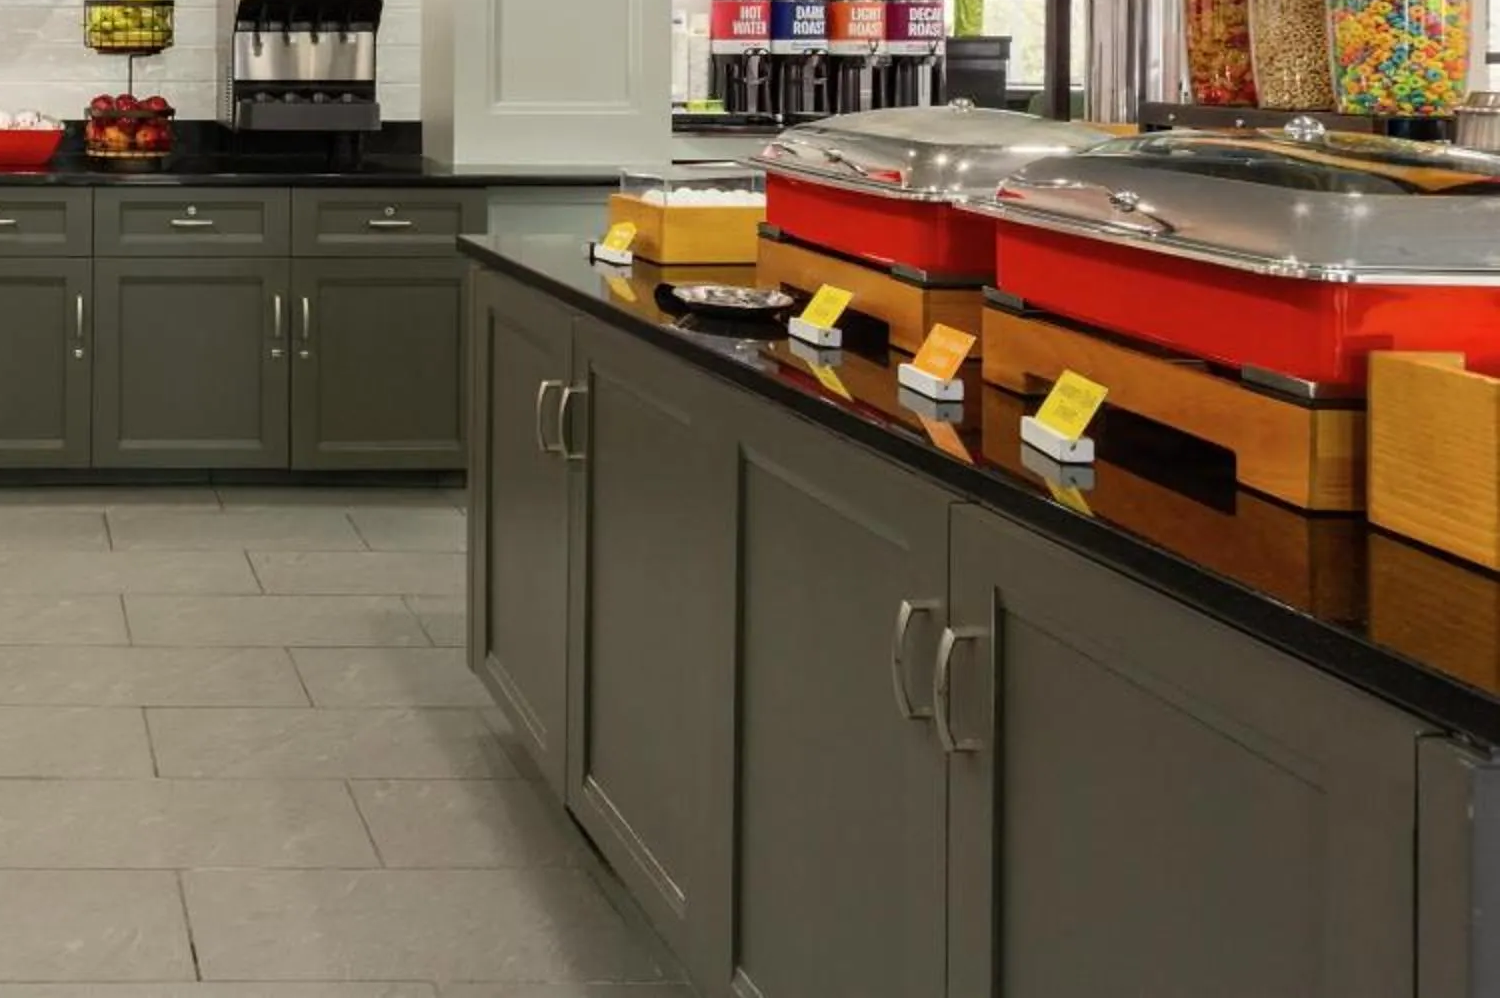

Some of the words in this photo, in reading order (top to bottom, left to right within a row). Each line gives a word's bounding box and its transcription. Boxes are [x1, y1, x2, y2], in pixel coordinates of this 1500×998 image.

[740, 5, 762, 20] HOT
[795, 5, 825, 20] DARK
[793, 21, 826, 35] ROAST
